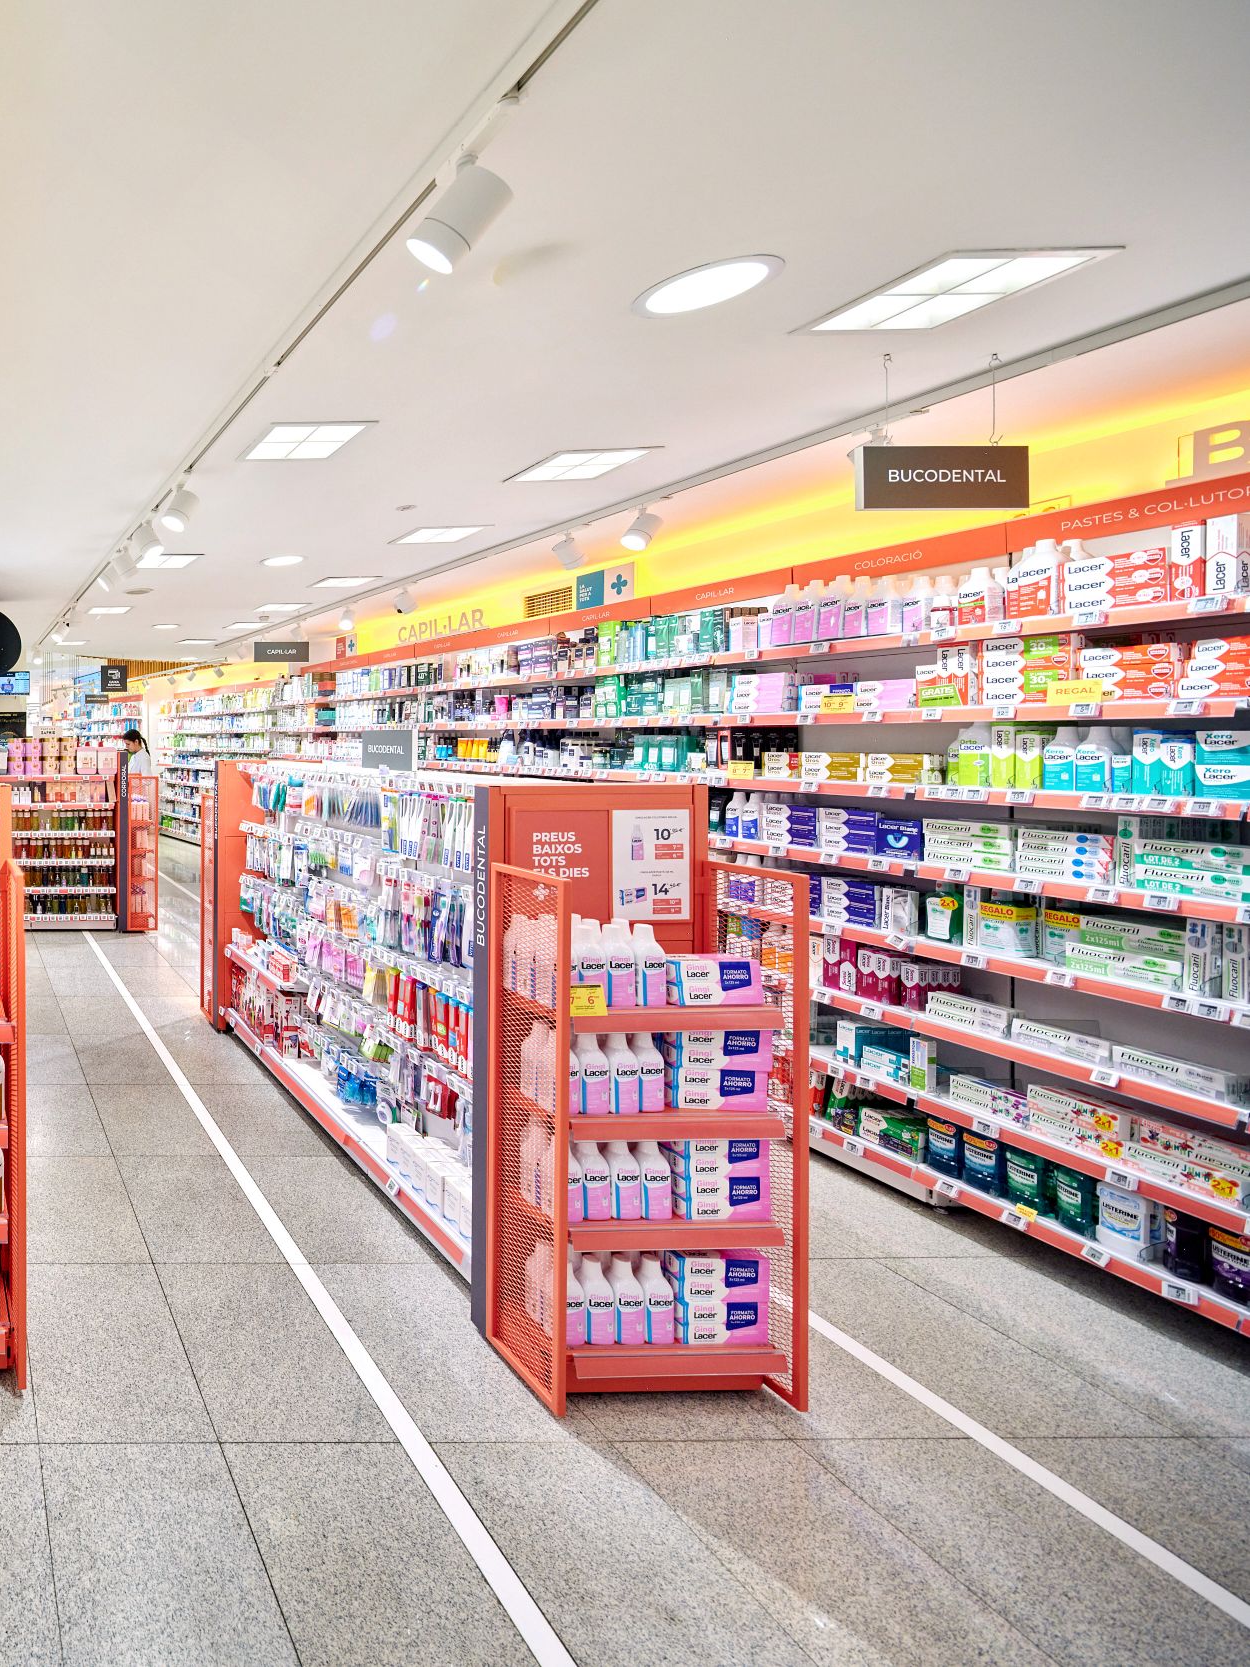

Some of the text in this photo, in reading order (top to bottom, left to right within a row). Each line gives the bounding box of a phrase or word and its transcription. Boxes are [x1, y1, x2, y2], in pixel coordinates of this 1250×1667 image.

[888, 469, 1006, 483] BUCODENTAL
[1061, 511, 1123, 531] PASTES
[1128, 509, 1139, 518] &
[1181, 530, 1193, 559] Lacer
[854, 550, 922, 571] COLORACIÓ
[1017, 566, 1053, 579] Lacer
[1068, 561, 1105, 575] Lacer
[1212, 560, 1227, 591] Lacer
[695, 587, 735, 601] CAPIL·LAR
[958, 590, 985, 600] Lacer
[1069, 598, 1106, 609] Lacer
[398, 608, 485, 643] CAPIL·LAR
[986, 641, 1022, 652] Lacer
[986, 658, 1018, 668] Lacer
[1083, 653, 1116, 662] Lacer
[1190, 663, 1220, 672] Lacer
[922, 687, 954, 696] GRATIS
[1055, 686, 1096, 695] REGAL
[1181, 682, 1212, 691] Lacer
[367, 745, 405, 755] BUCODENTAL
[1044, 753, 1073, 761] Lacer
[925, 822, 971, 833] Fluocaril
[533, 832, 575, 842] PREUS
[654, 828, 670, 840] 10
[1022, 832, 1069, 842] Fluocaril
[533, 844, 582, 854] BAIXOS
[1143, 843, 1205, 855] Fluocaril
[532, 856, 566, 866] TOTS
[927, 851, 973, 863] Fluocaril
[1143, 855, 1159, 863] LOT
[1122, 842, 1131, 886] Fluocaril
[560, 868, 589, 878] DIES
[1144, 868, 1205, 881] Fluocaril
[476, 825, 487, 947] BUCODENTAL
[652, 883, 669, 895] 14
[940, 899, 956, 908] 2x1
[981, 905, 1014, 916] REGALO
[1044, 911, 1080, 924] REGALO
[1085, 920, 1140, 935] Fluocaril
[1071, 947, 1125, 963] Fluocaril
[581, 962, 606, 970] Lacer
[610, 961, 634, 969] Lacer
[645, 961, 666, 969] Lacer
[687, 970, 710, 978] Lacer
[1229, 959, 1238, 998] Fluocaril
[931, 996, 977, 1013] Fluocaril
[1019, 1023, 1071, 1043] Fluocaril
[1120, 1052, 1179, 1074] Fluocaril
[685, 1090, 708, 1098] Gingi
[1029, 1088, 1071, 1107] Fluocaril
[684, 1097, 710, 1105] Lacer
[1094, 1116, 1112, 1129] 2x1
[1127, 1146, 1180, 1168] Fluocaril
[1212, 1180, 1234, 1194] 2x1
[1102, 1202, 1139, 1221] LISTERINE
[589, 1300, 613, 1308] Lacer
[649, 1298, 674, 1306] Lacer
[694, 1332, 717, 1340] Lacer
